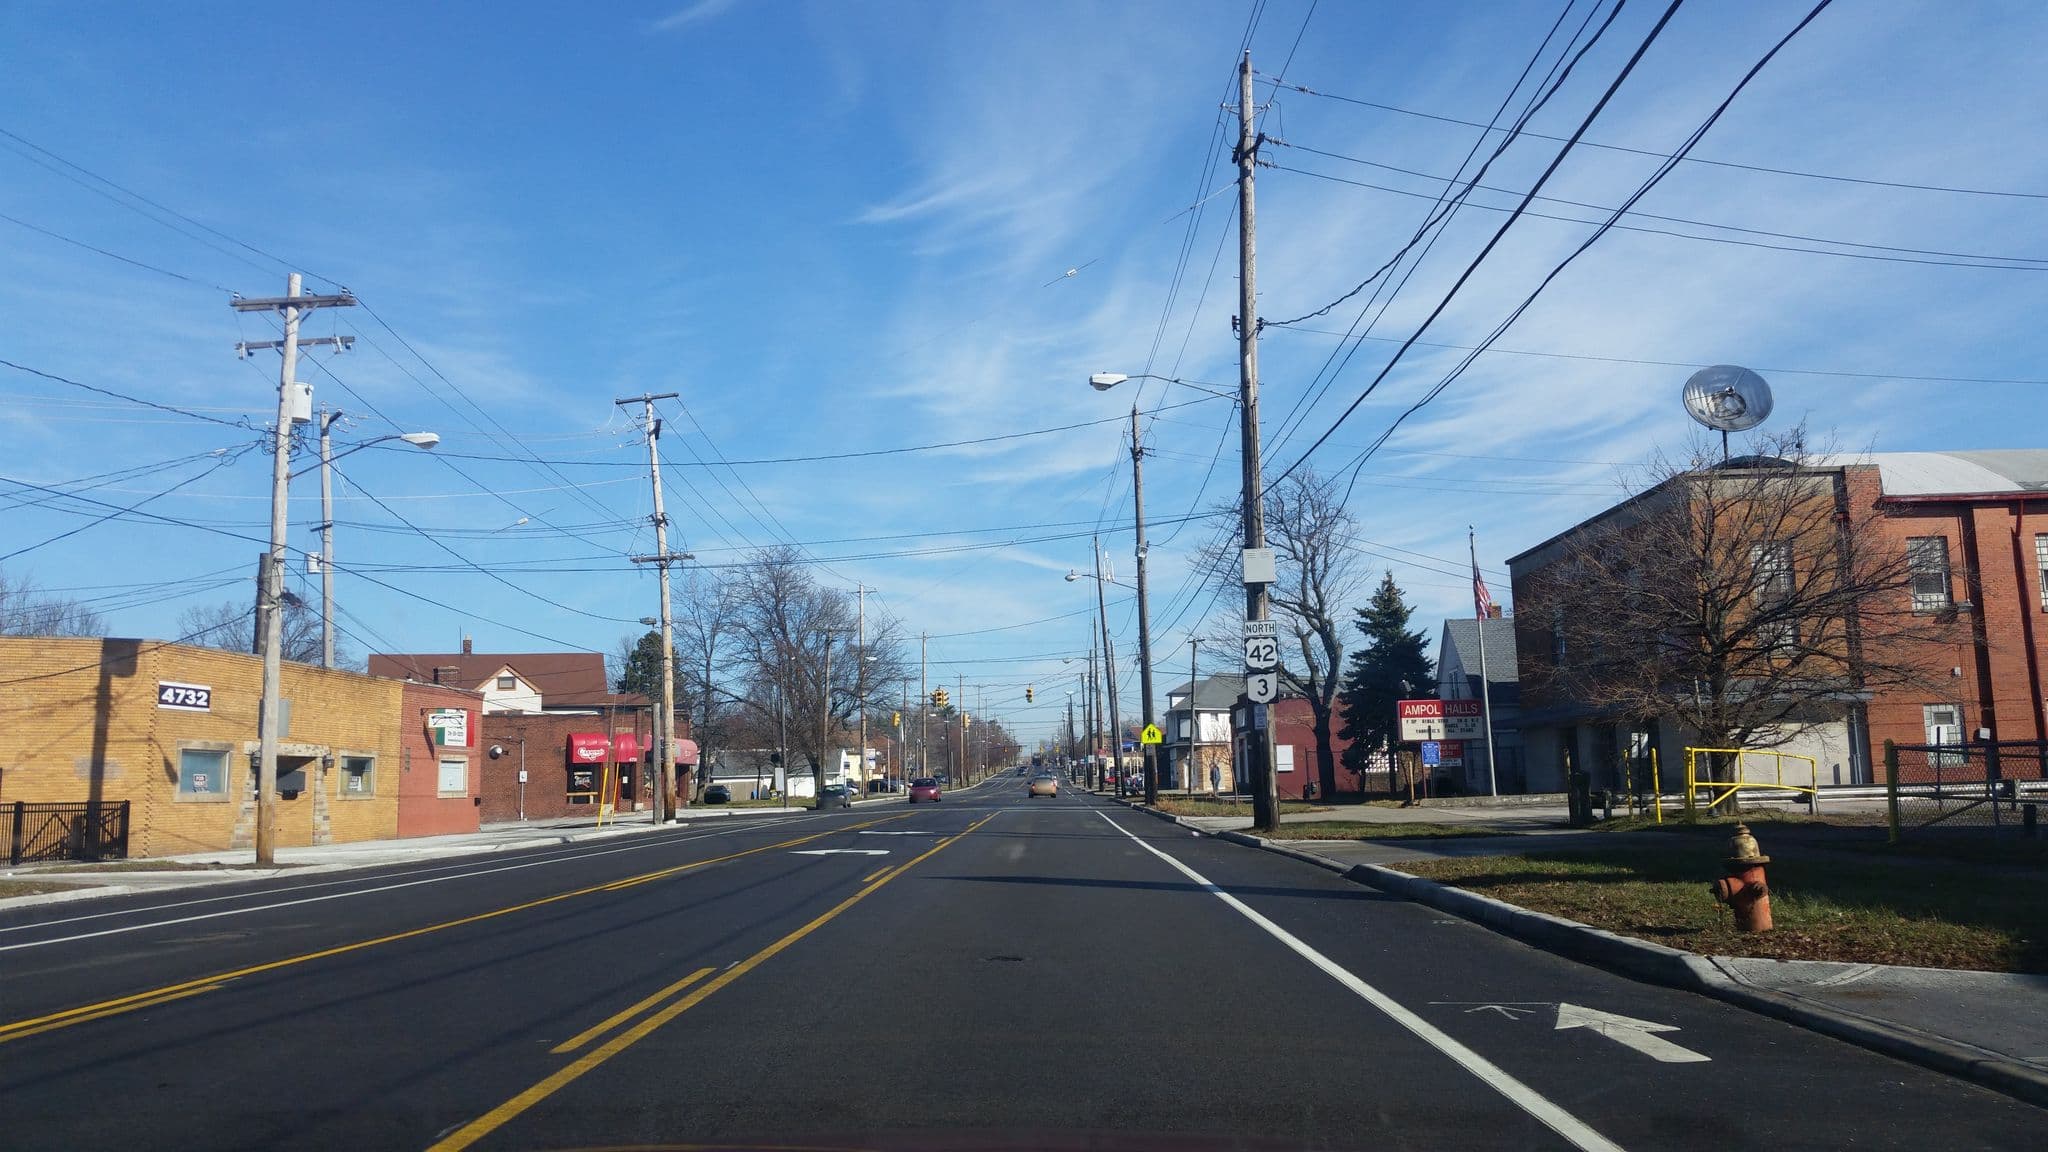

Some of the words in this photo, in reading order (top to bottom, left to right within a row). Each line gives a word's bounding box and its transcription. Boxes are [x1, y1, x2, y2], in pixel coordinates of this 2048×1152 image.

[1245, 623, 1275, 633] NORTH
[1249, 645, 1275, 662] 42
[1257, 678, 1268, 696] 3
[161, 687, 208, 706] 4732
[1404, 704, 1441, 716] AMPOL
[1444, 703, 1478, 715] HALLS
